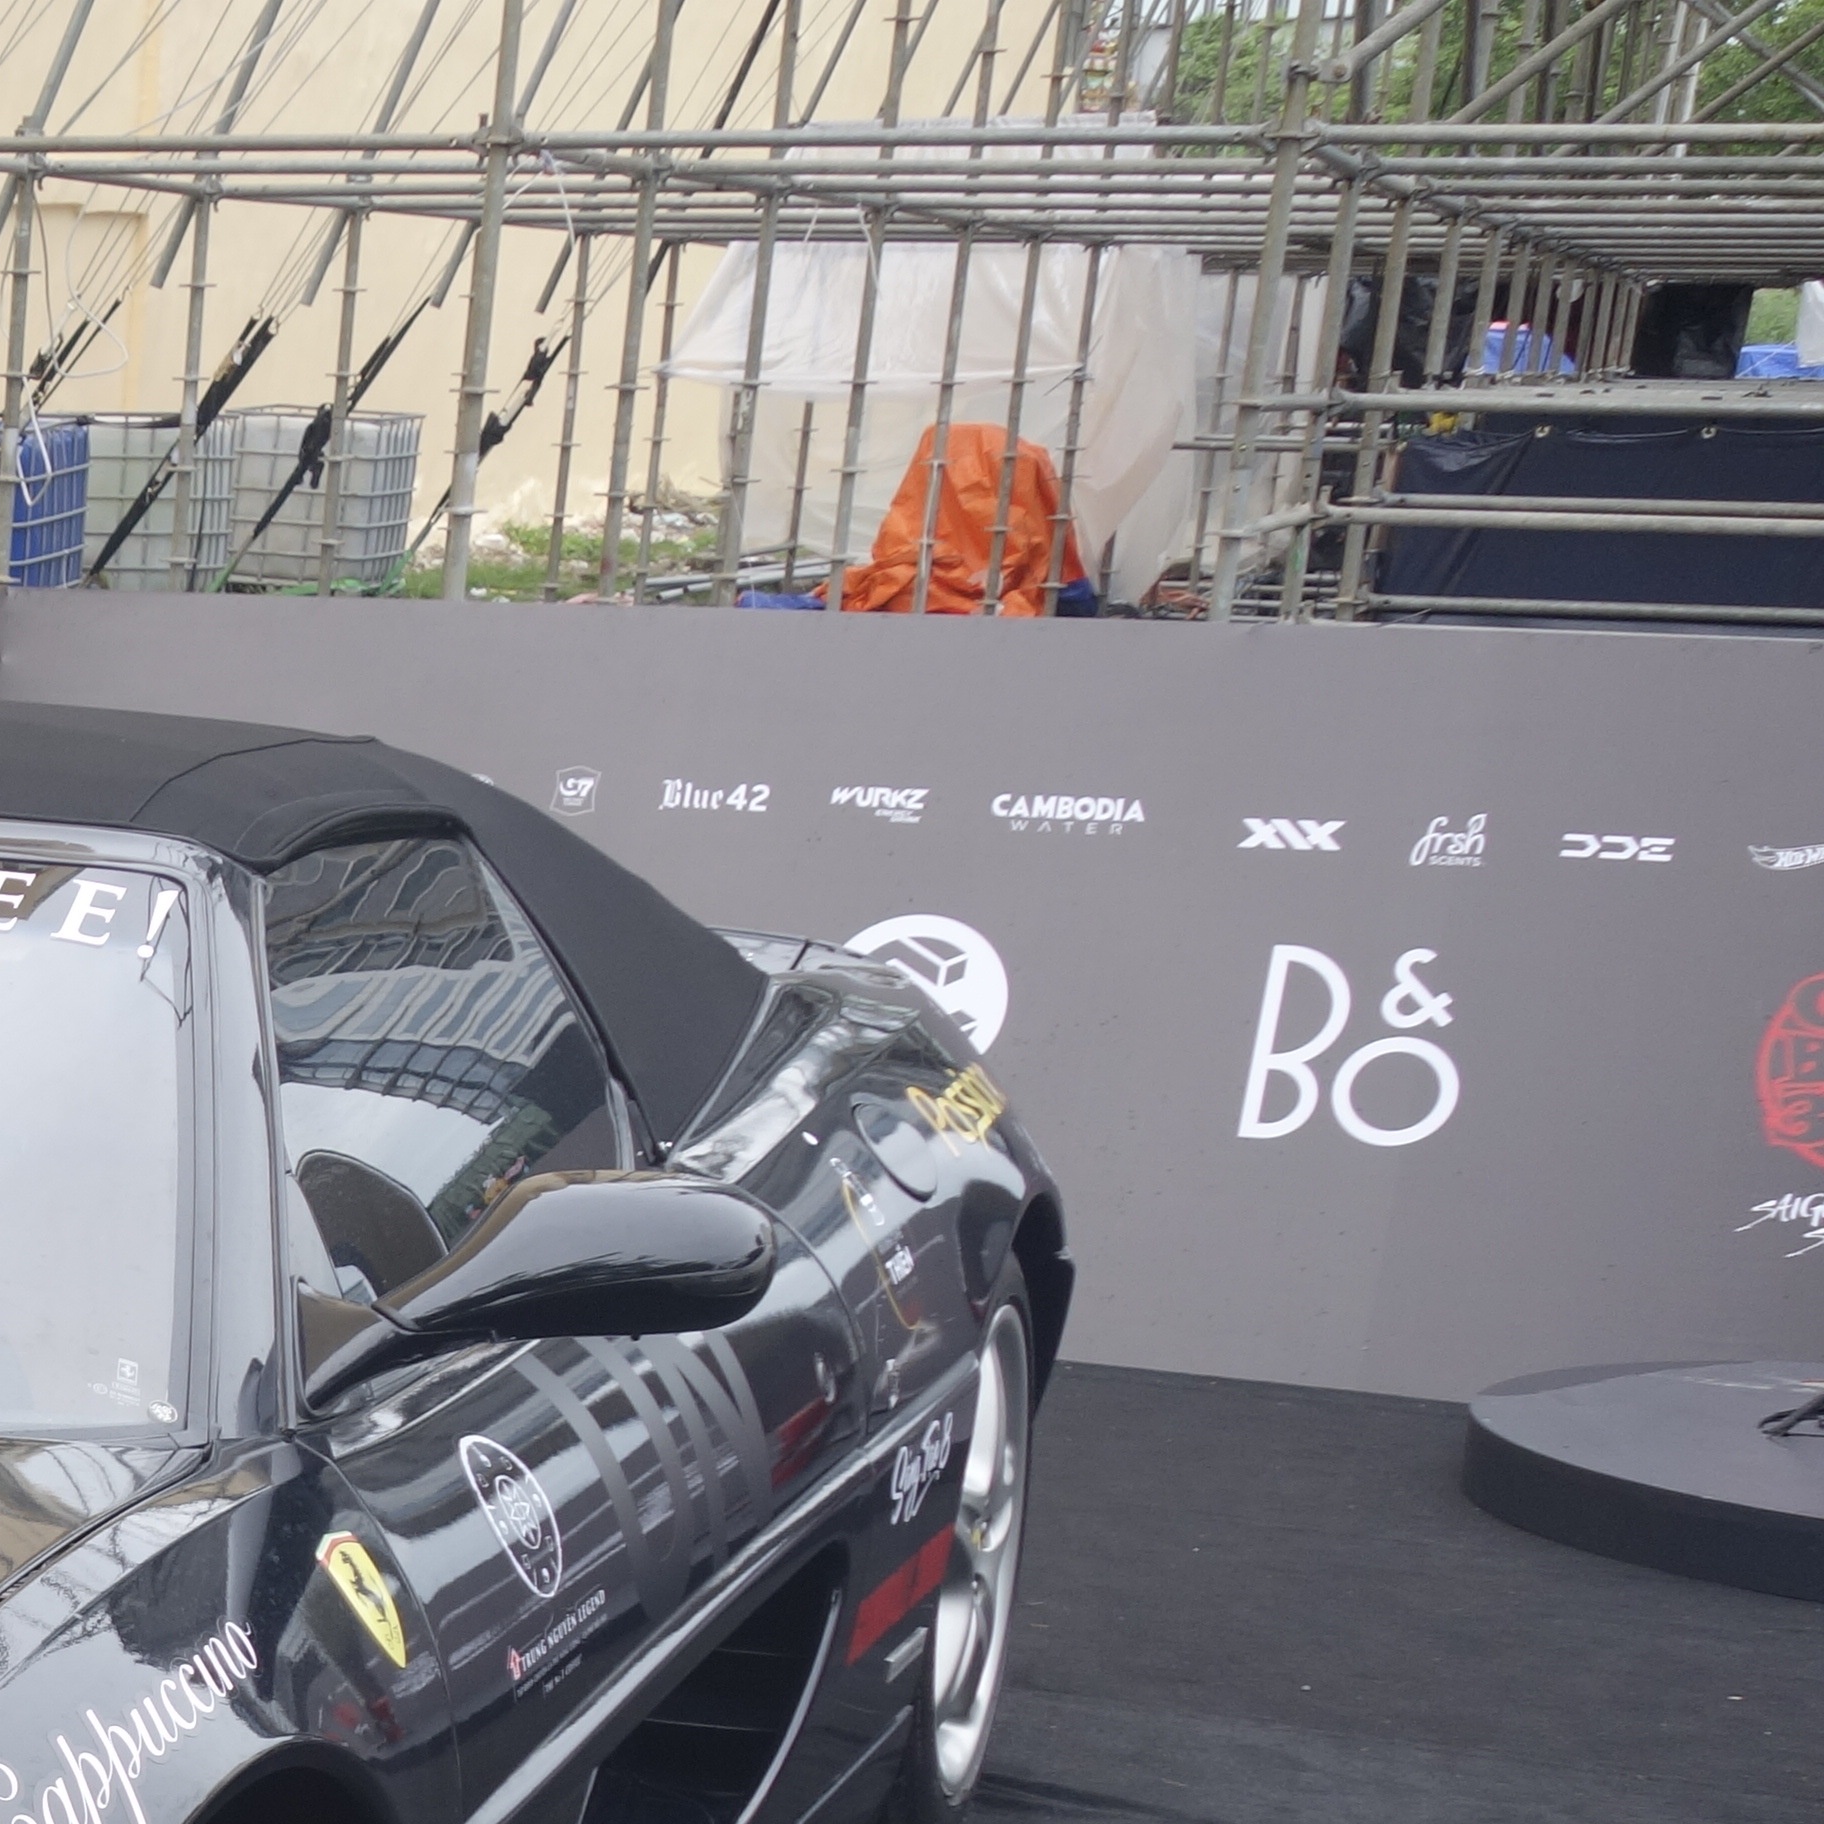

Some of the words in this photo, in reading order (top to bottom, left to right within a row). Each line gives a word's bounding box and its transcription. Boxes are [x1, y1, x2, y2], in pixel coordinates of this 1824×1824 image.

[829, 785, 931, 810] WURKZ
[990, 792, 1146, 823] CAMBODIA
[1009, 819, 1124, 836] WATER
[1428, 854, 1482, 867] SCENTS
